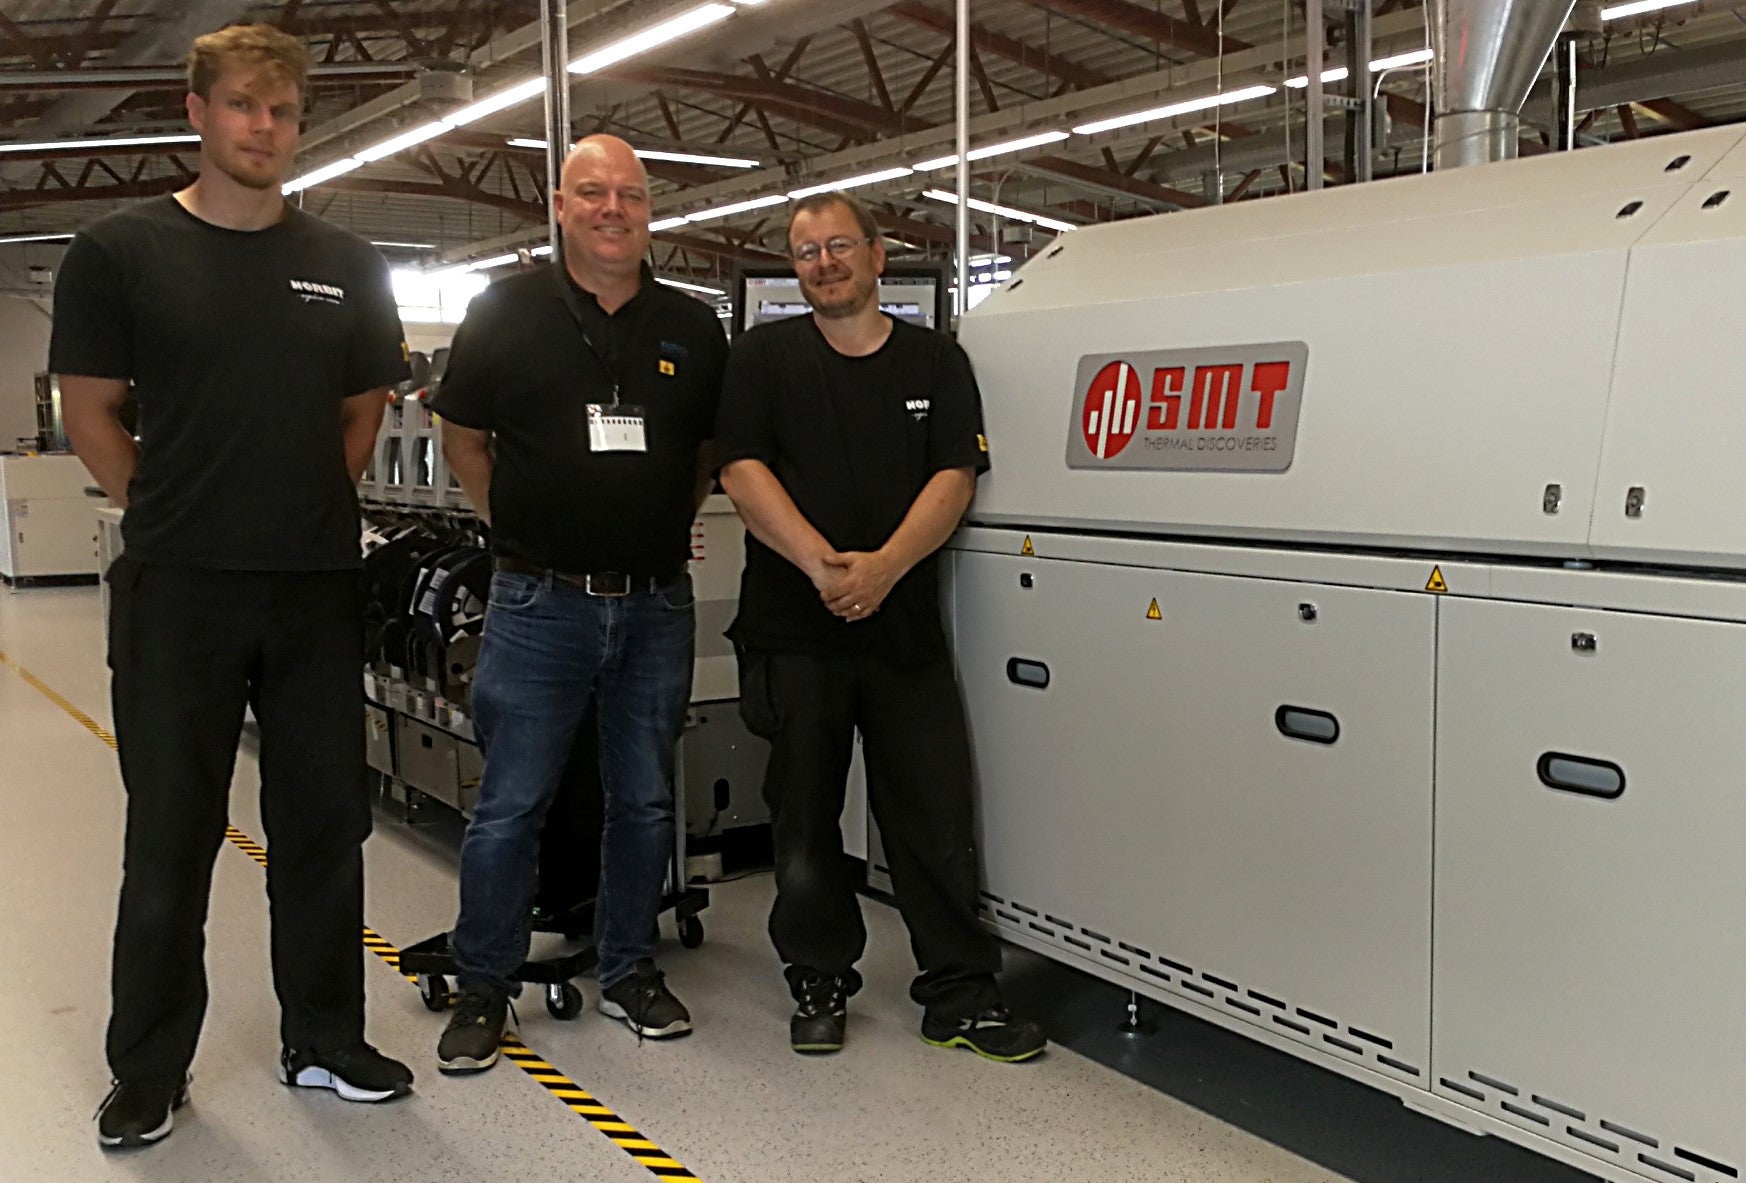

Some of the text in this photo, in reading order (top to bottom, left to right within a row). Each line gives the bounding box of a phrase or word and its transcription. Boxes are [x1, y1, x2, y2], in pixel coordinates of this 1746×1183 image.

[1147, 361, 1290, 430] SMT
[1144, 436, 1277, 451] THERMAL DISCOVERIES
